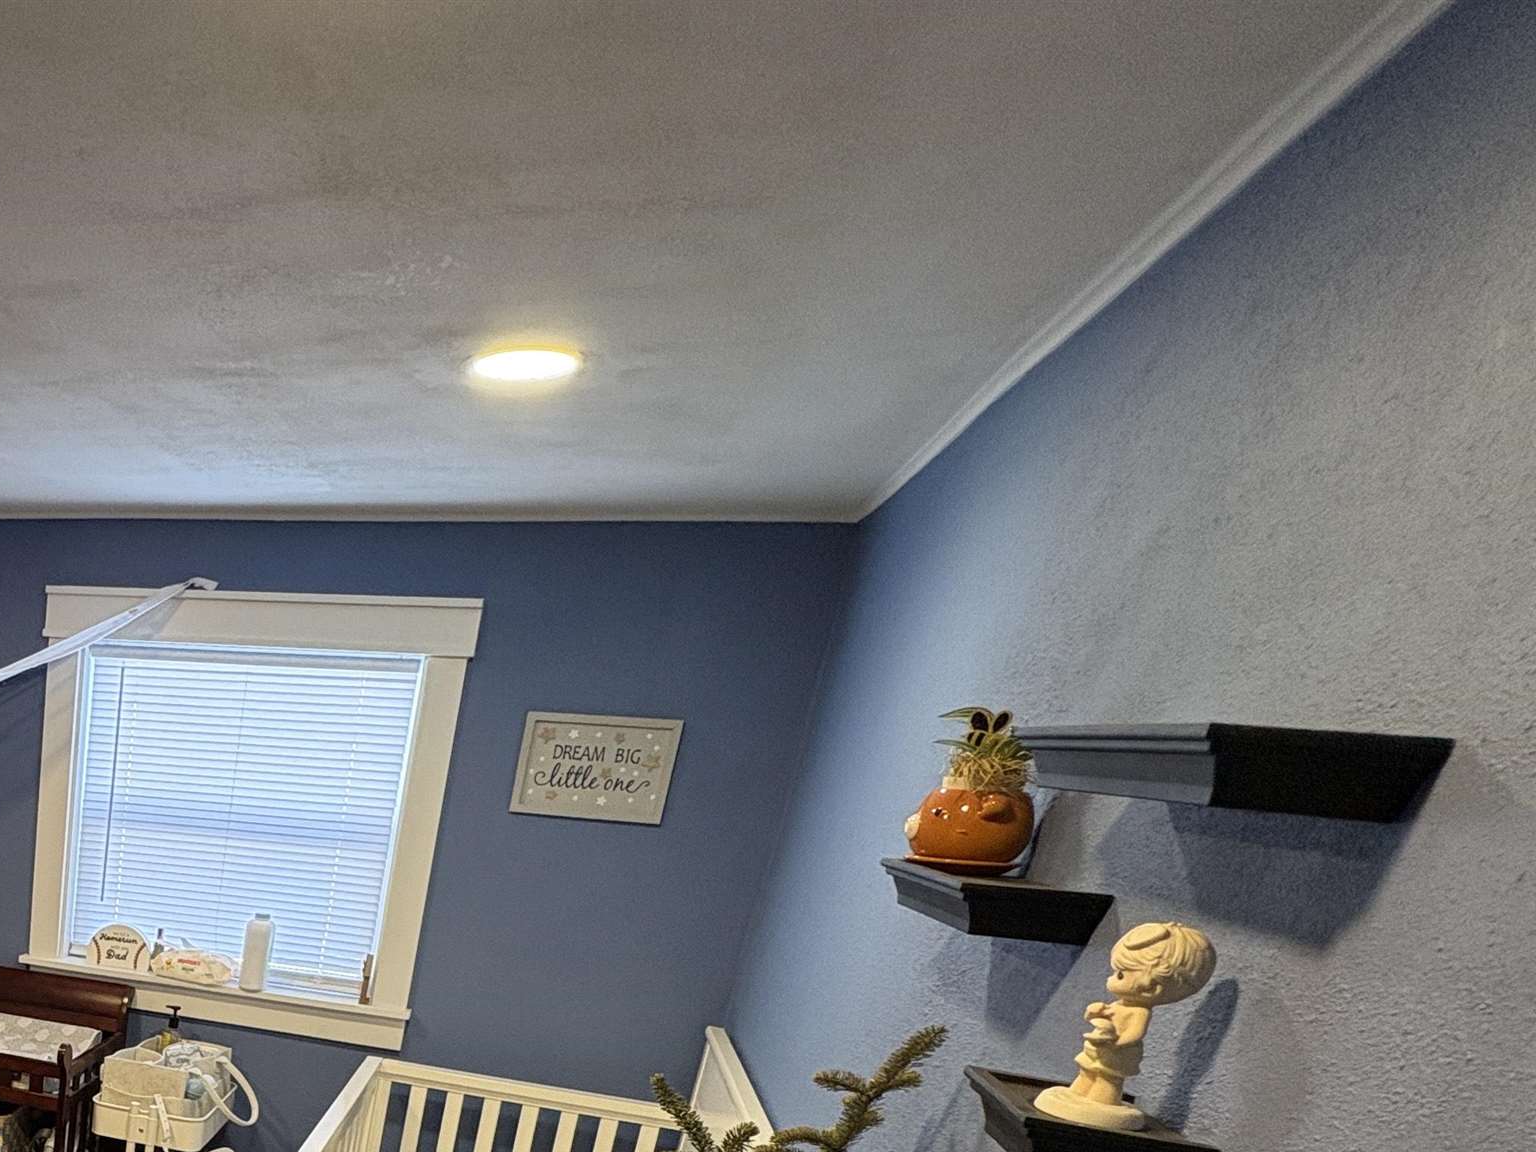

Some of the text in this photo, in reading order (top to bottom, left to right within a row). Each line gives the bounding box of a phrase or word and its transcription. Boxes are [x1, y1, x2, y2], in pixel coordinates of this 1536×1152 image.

[552, 744, 642, 765] DREAM BIG
[534, 762, 651, 794] little one
[105, 948, 129, 961] Dad
